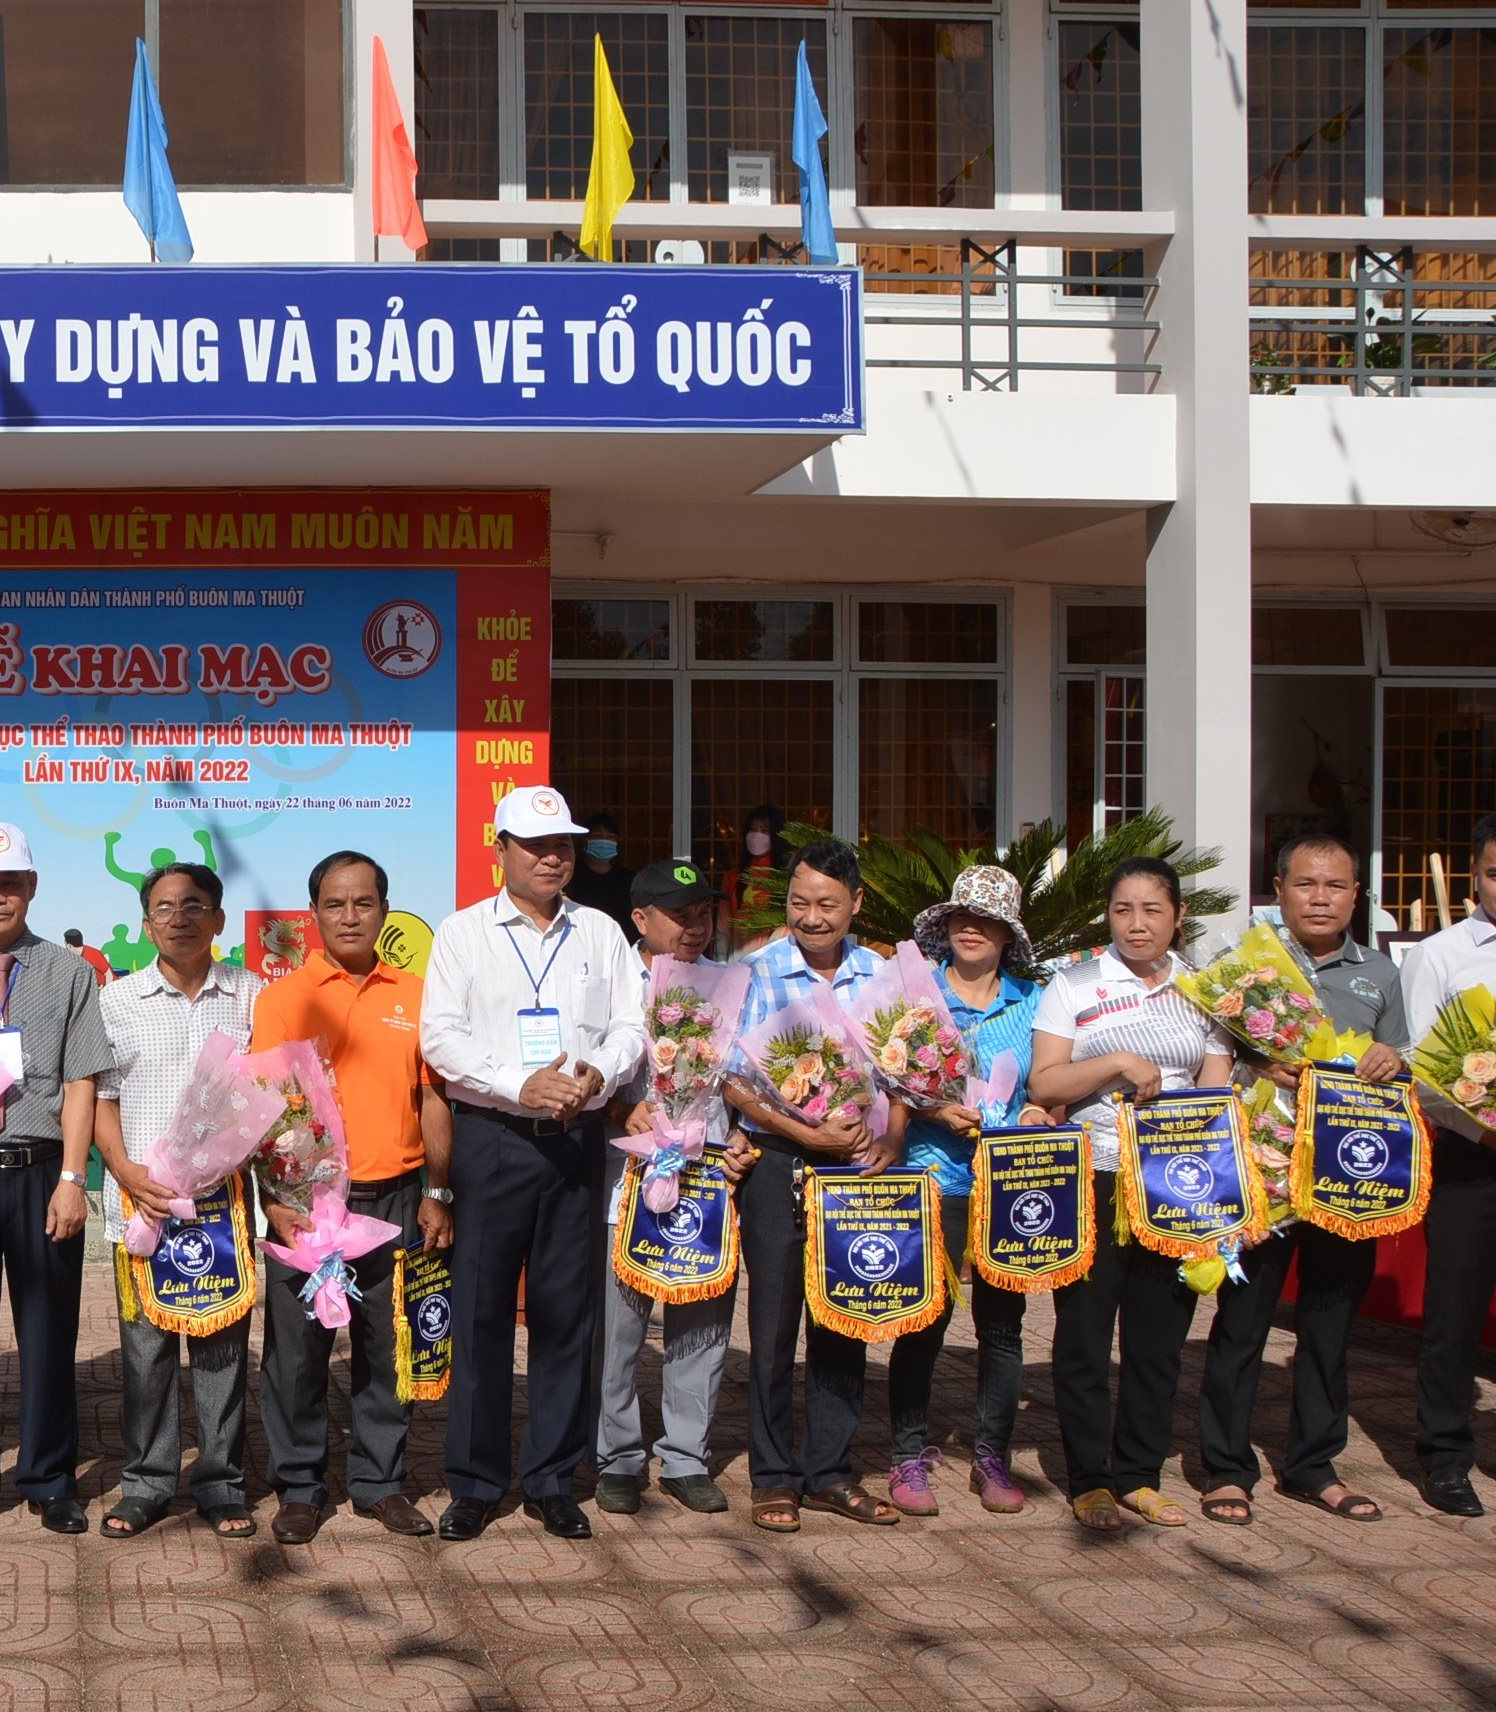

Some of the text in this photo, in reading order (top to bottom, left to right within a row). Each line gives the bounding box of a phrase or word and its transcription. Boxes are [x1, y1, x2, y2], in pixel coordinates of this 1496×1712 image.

[55, 313, 219, 399] DỰNG
[239, 305, 317, 384] VÀ
[337, 296, 454, 384] BẢO
[473, 305, 545, 399] VỆ
[564, 294, 638, 384] TỔ
[657, 298, 812, 394] QUỐC
[89, 506, 172, 558] VIỆT
[185, 513, 276, 550] NAM
[291, 505, 409, 550] MUÔN
[422, 505, 514, 550] NĂM
[25, 588, 67, 608] NHÂN
[70, 588, 101, 607] DÂN
[104, 588, 152, 607] THÀNH
[155, 584, 186, 607] PHỐ
[189, 588, 229, 607] BUÔN
[232, 590, 256, 607] MA
[260, 587, 305, 611] THUỘT
[477, 609, 532, 641] KHỎE
[30, 643, 191, 695] KHAI
[197, 643, 332, 707] MẠC
[490, 648, 519, 681] ĐỂ
[484, 694, 525, 723] XÂY
[30, 715, 70, 747] THỂ
[72, 724, 126, 747] THAO
[129, 719, 197, 747] THÀNH
[202, 716, 245, 747] PHỐ
[249, 719, 306, 747] BUÔN
[311, 723, 344, 747] MA
[349, 718, 413, 751] THUỘT
[475, 738, 534, 769] DỰNG
[23, 753, 250, 785] LẦN THỨ IX, NĂM 2022
[154, 797, 412, 811] Buôn Ma Thuột, ngày 22 tháng 06 năm 2022
[273, 967, 292, 977] BIA
[1313, 1176, 1405, 1200] Lưu Niệm
[1152, 1202, 1240, 1219] Lưu Niệm
[632, 1239, 715, 1265] Lưu Niệm
[993, 1236, 1074, 1253] Lưu Niệm
[159, 1275, 235, 1295] Lưu Niệm
[830, 1282, 920, 1299] Lưu Niệm
